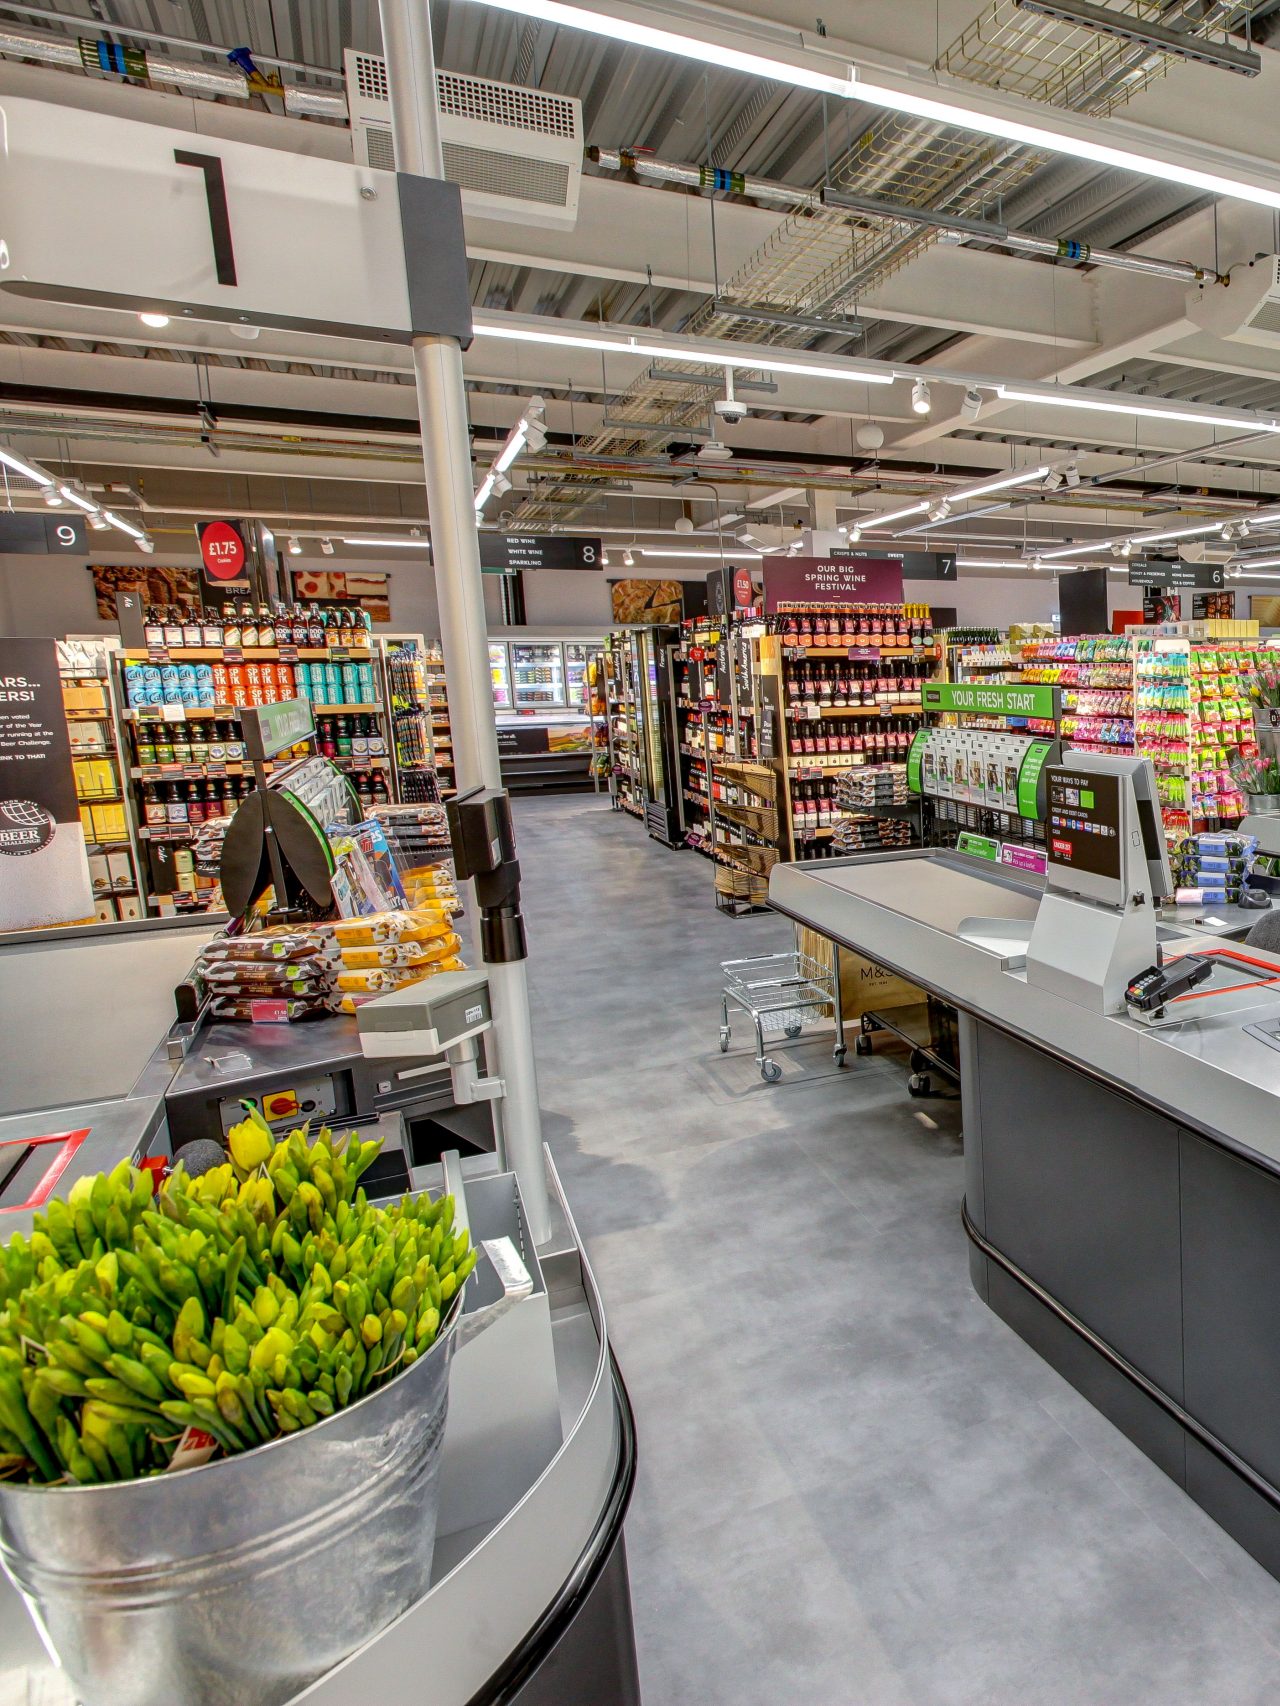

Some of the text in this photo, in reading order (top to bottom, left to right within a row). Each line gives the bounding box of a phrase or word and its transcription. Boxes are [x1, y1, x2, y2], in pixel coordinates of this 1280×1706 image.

[173, 149, 238, 287] 1
[57, 525, 76, 546] 9
[209, 541, 237, 556] £1.75
[582, 546, 595, 563] 8
[817, 565, 837, 573] OUR
[942, 559, 951, 574] 7
[805, 574, 840, 582] SPRING
[1212, 570, 1221, 583] 6
[815, 583, 857, 591] FESTIVAL
[215, 668, 225, 676] SP
[229, 668, 239, 676] SP
[247, 668, 258, 676] SP
[277, 667, 287, 675] SP
[216, 676, 227, 684] TK
[229, 676, 240, 684] TK
[248, 676, 260, 684] TK
[261, 675, 273, 684] TK
[278, 676, 289, 684] TK
[216, 690, 226, 698] SP
[235, 690, 246, 698] SP
[265, 689, 276, 697] SP
[281, 689, 292, 697] SP
[952, 690, 975, 707] YOUR
[976, 691, 1004, 709] FRESH
[1007, 693, 1036, 711] START
[1062, 776, 1073, 784] WAYS
[0, 831, 40, 841] BEER
[860, 966, 894, 980] M&
